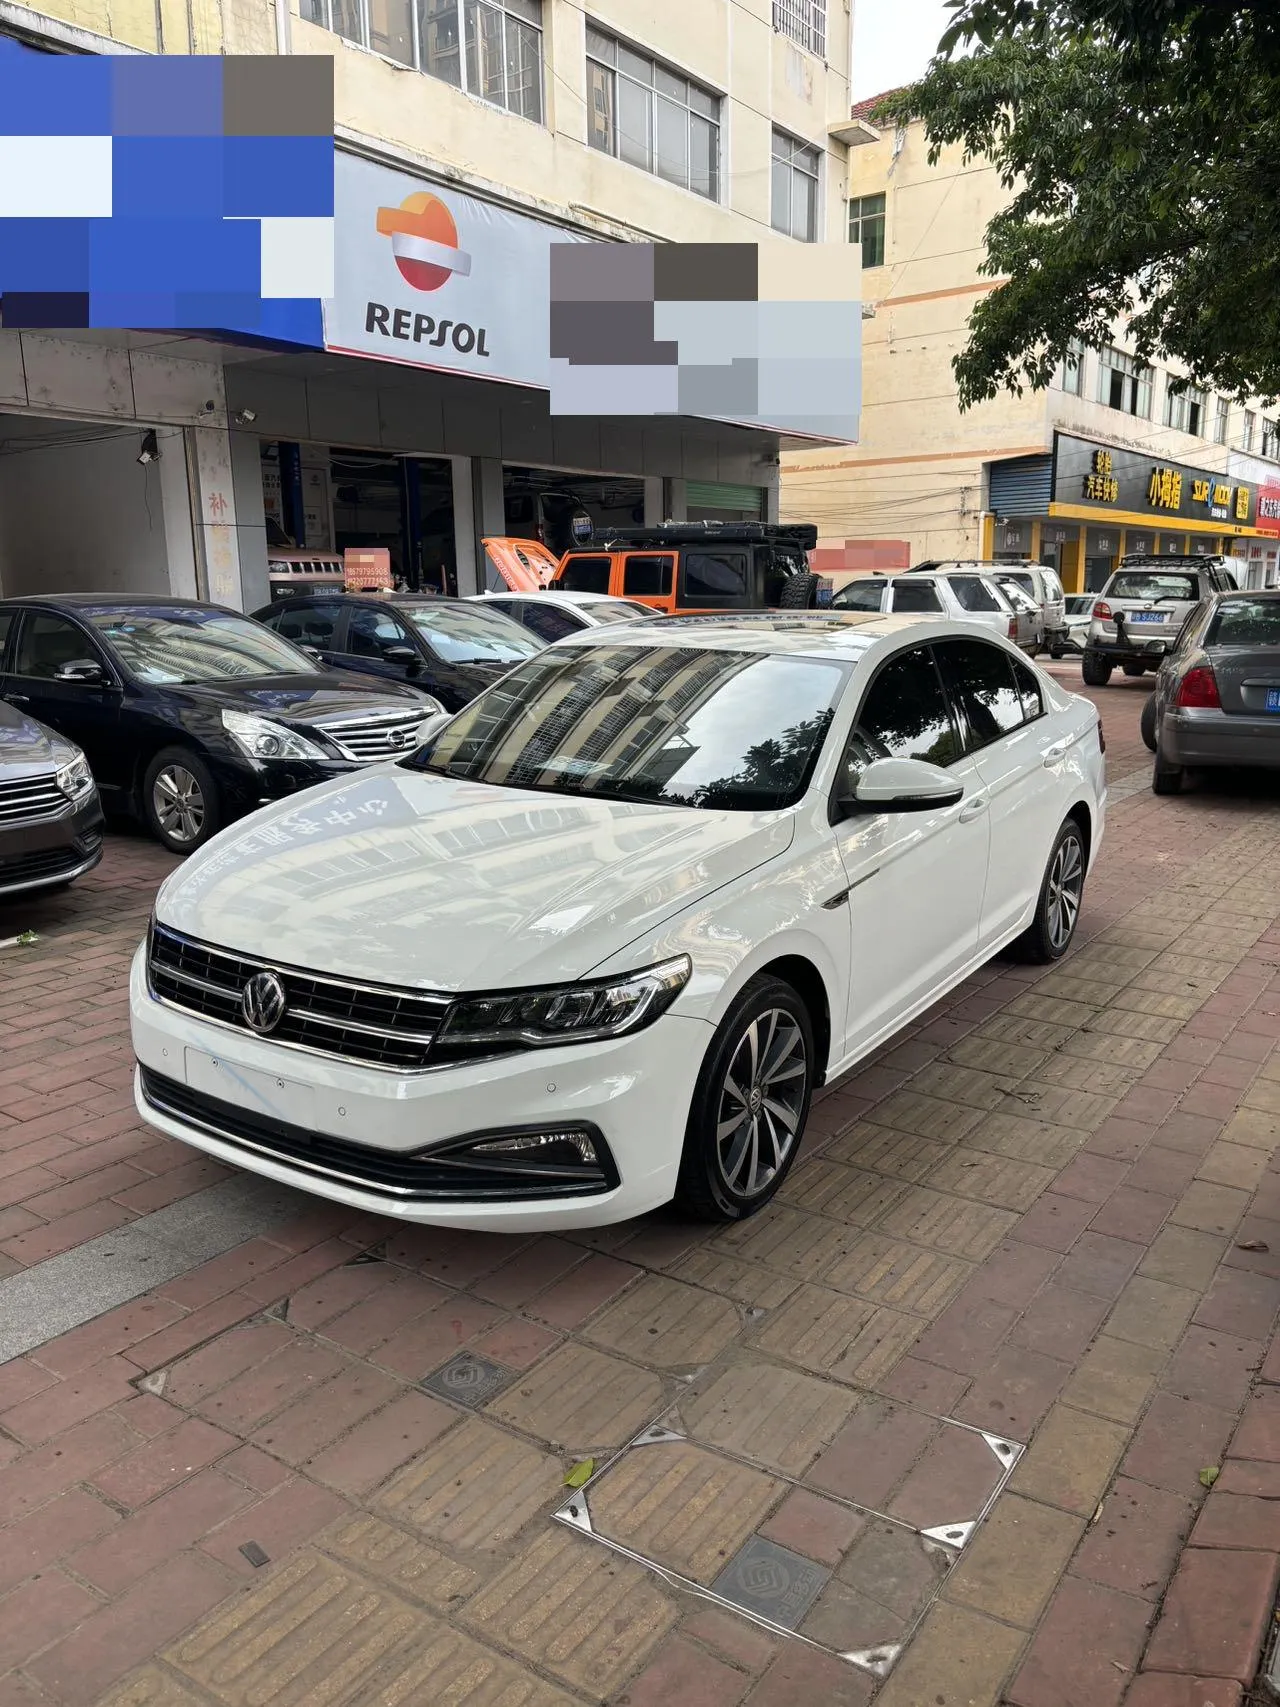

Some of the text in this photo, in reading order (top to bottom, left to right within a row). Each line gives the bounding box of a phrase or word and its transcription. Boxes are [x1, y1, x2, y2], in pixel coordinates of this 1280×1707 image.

[365, 301, 490, 357] REPSOL
[1149, 466, 1181, 510] 小拇指
